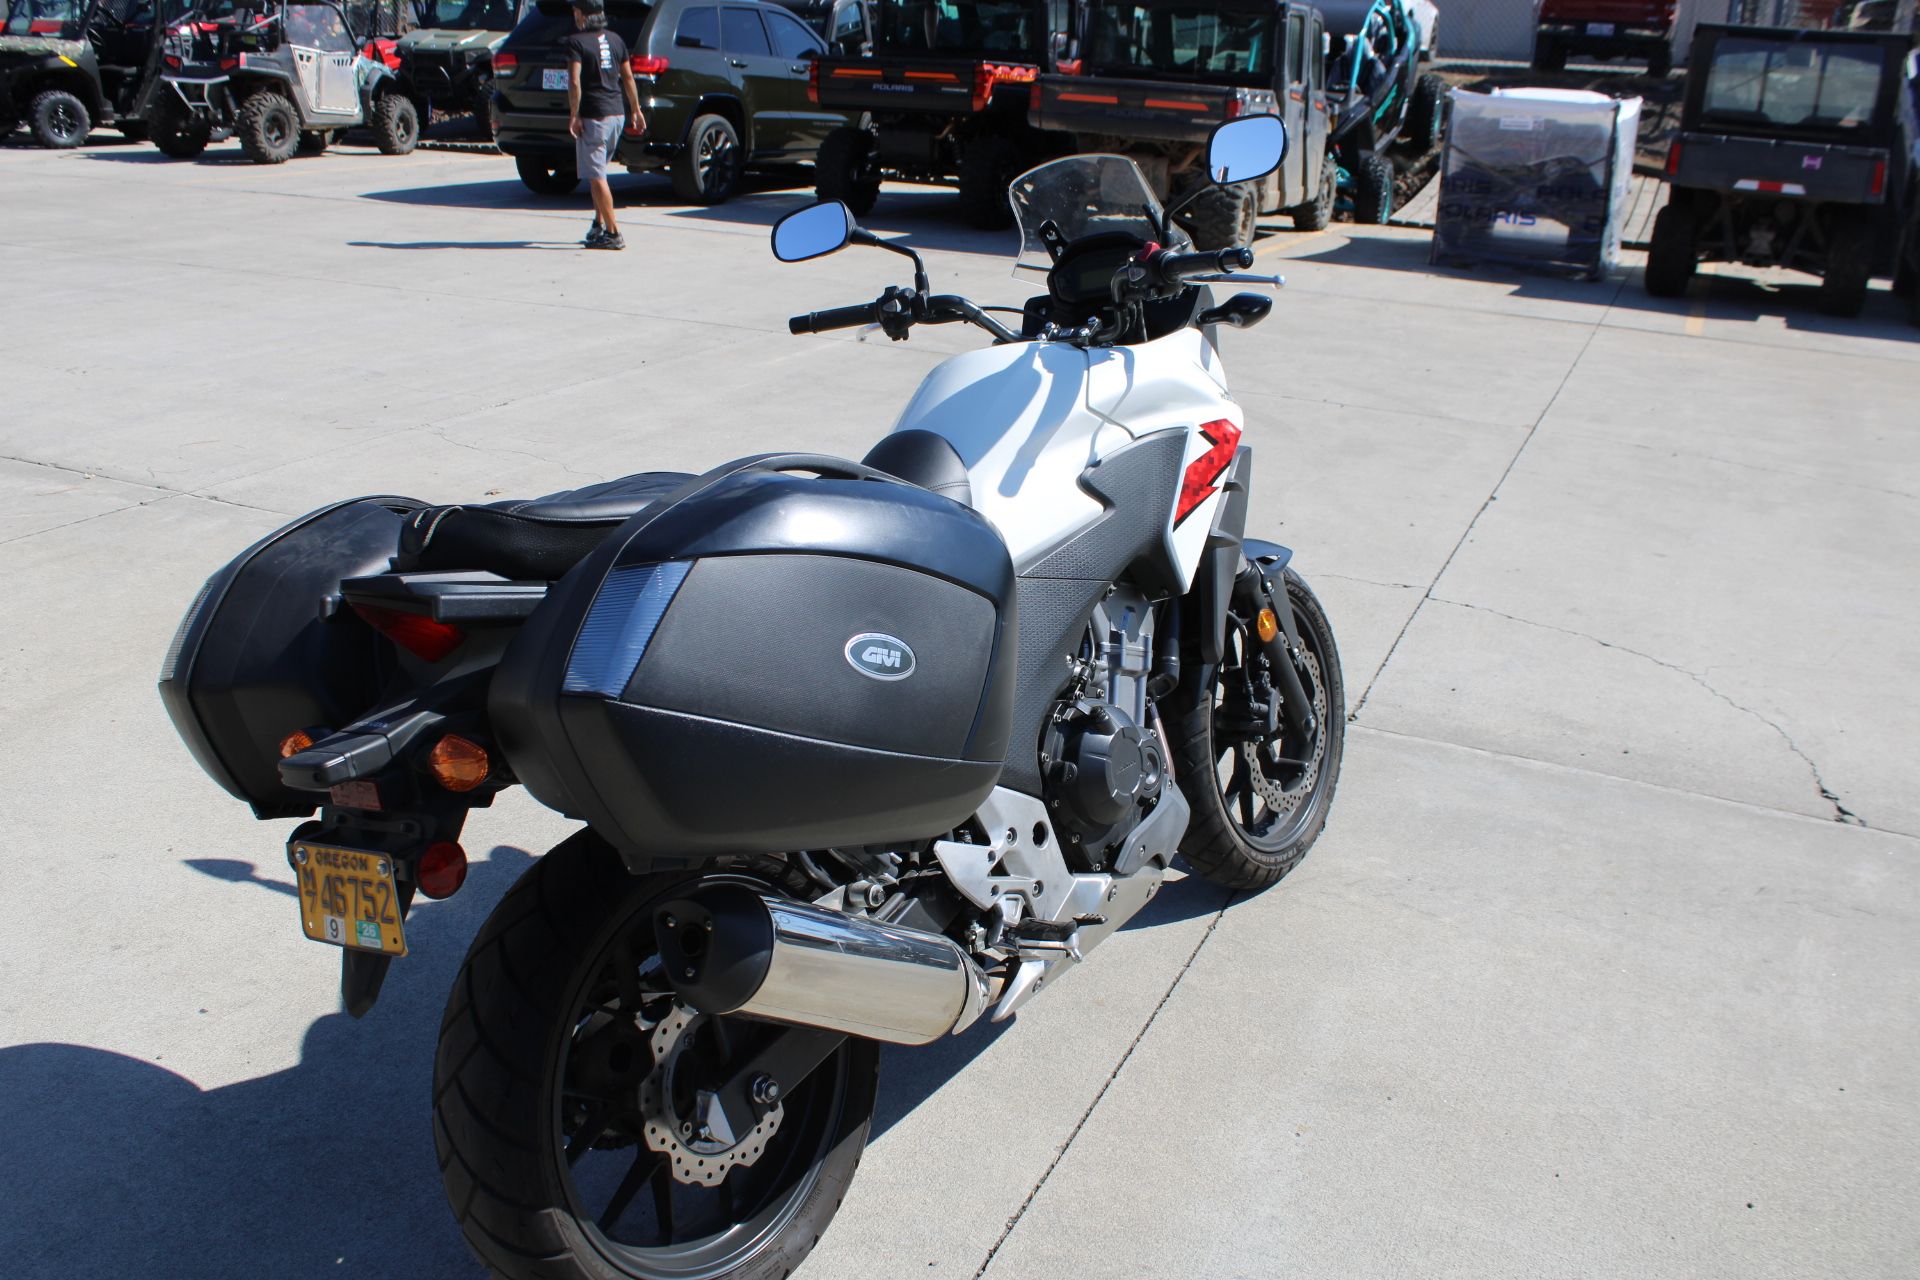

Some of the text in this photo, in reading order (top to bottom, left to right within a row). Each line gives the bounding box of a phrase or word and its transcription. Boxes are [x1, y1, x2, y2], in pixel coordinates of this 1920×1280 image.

[872, 83, 914, 93] POLARIS
[862, 646, 901, 668] GIVI
[315, 850, 368, 870] OREGON
[321, 874, 395, 924] 46752
[329, 918, 339, 939] 9
